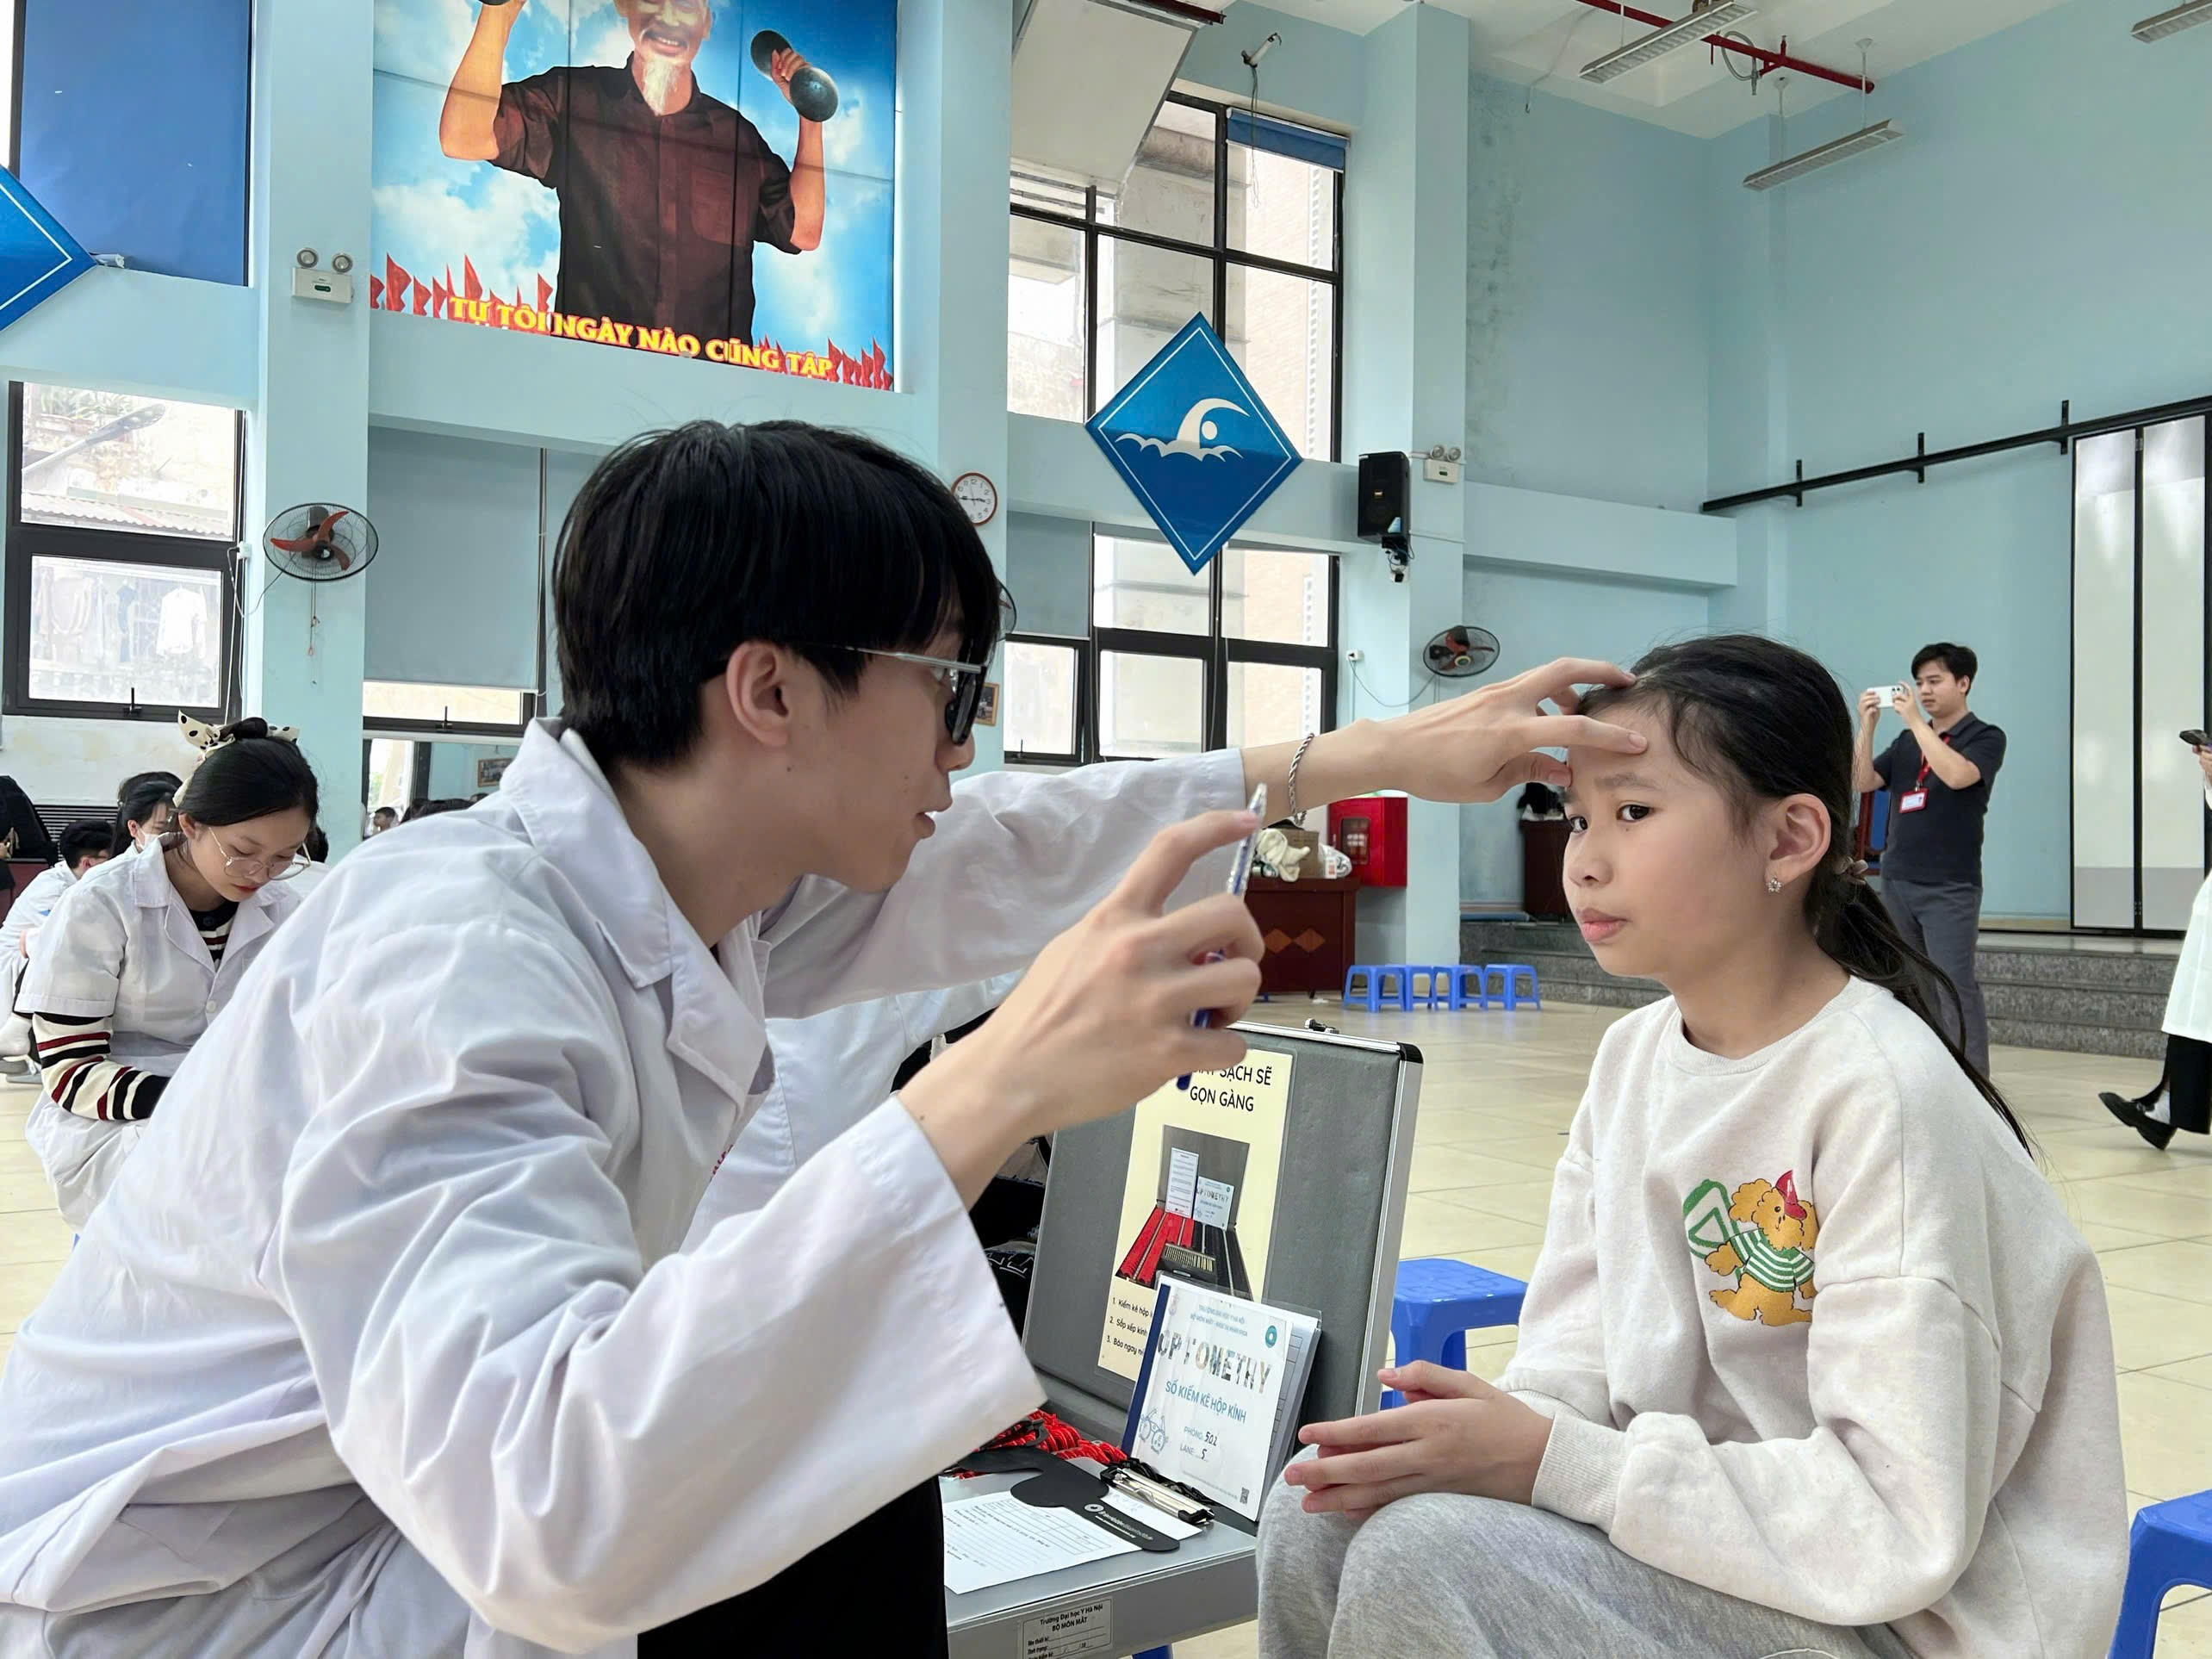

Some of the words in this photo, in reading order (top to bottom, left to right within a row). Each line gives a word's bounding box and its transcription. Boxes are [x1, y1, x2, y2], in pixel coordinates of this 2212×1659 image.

[450, 296, 490, 325] TỰ
[496, 304, 547, 332] TÔI
[552, 313, 633, 347] NGÀY
[637, 326, 700, 357] NÀO
[705, 337, 779, 370] CŨNG
[786, 351, 833, 378] TẬP
[1220, 1066, 1252, 1082] SẠCH
[1256, 1066, 1272, 1085] SẼ
[1190, 1086, 1216, 1105] GỌN
[1220, 1089, 1254, 1111] GÀNG
[1200, 1393, 1211, 1408] KÊ
[1211, 1397, 1227, 1415] HỘP
[1227, 1404, 1247, 1424] KÍNH
[1204, 1432, 1218, 1446] 502
